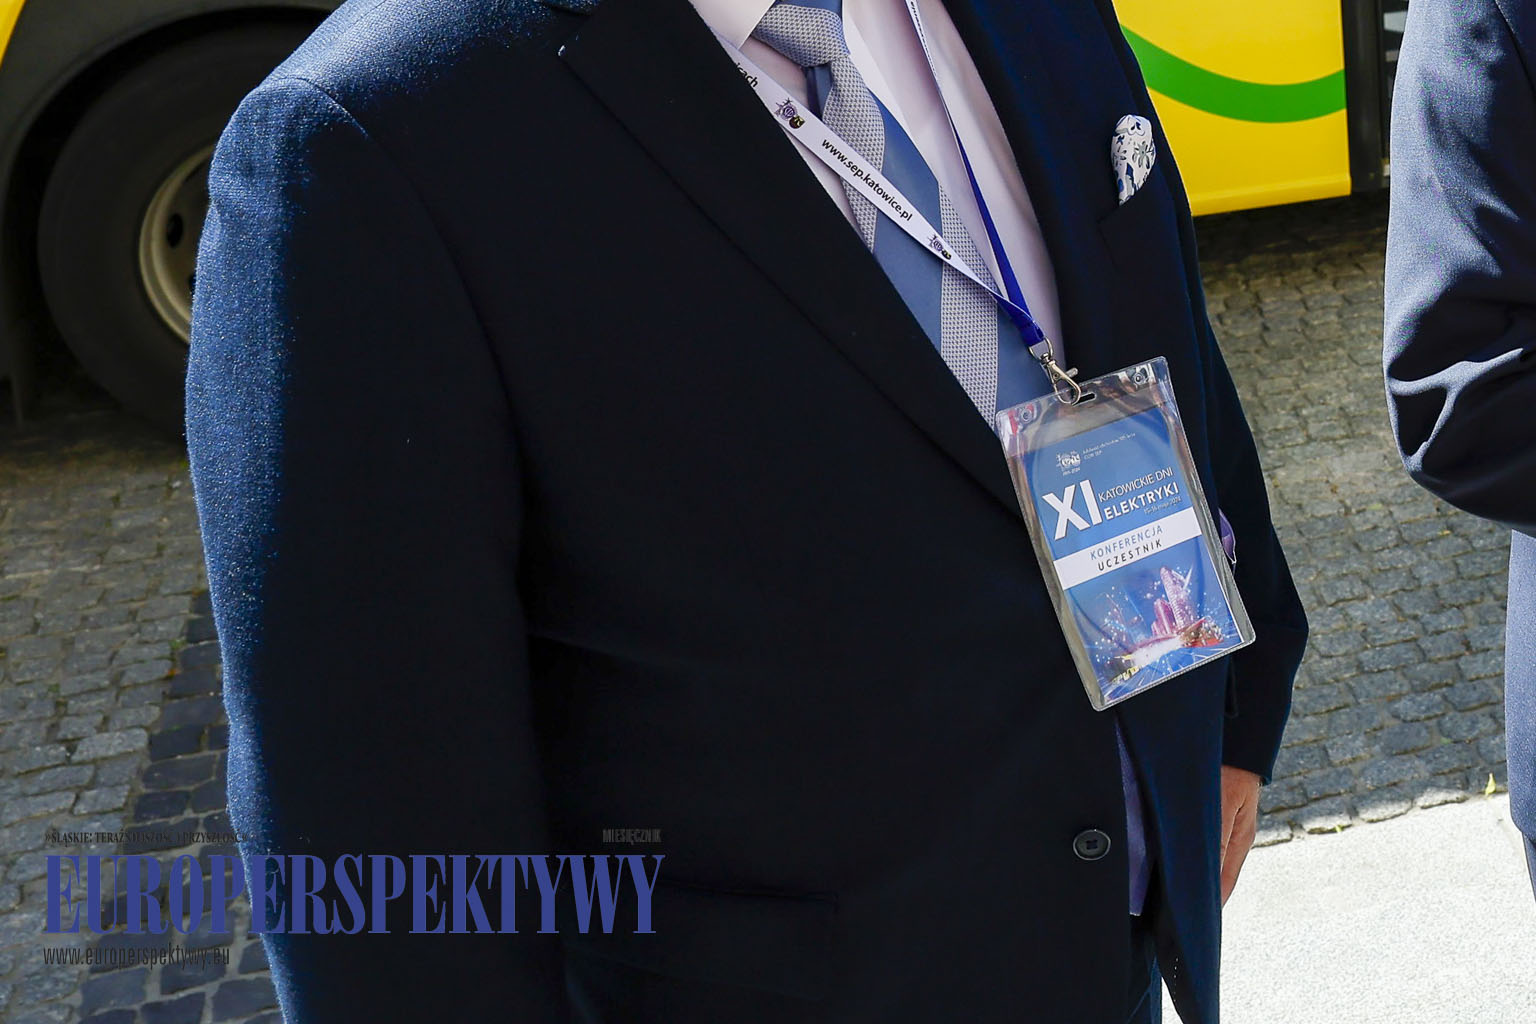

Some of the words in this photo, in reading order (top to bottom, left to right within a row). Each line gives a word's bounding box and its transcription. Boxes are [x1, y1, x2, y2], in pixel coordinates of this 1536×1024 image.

[822, 138, 913, 223] www.sep.katowice.pl
[1098, 474, 1155, 503] KATOWICKIE
[1154, 466, 1174, 481] DNI
[1104, 481, 1180, 521] ELEKTRYKI
[1042, 479, 1103, 541] XI
[1090, 525, 1164, 560] KONFERENCJA
[1097, 539, 1162, 572] UCZESTNIK
